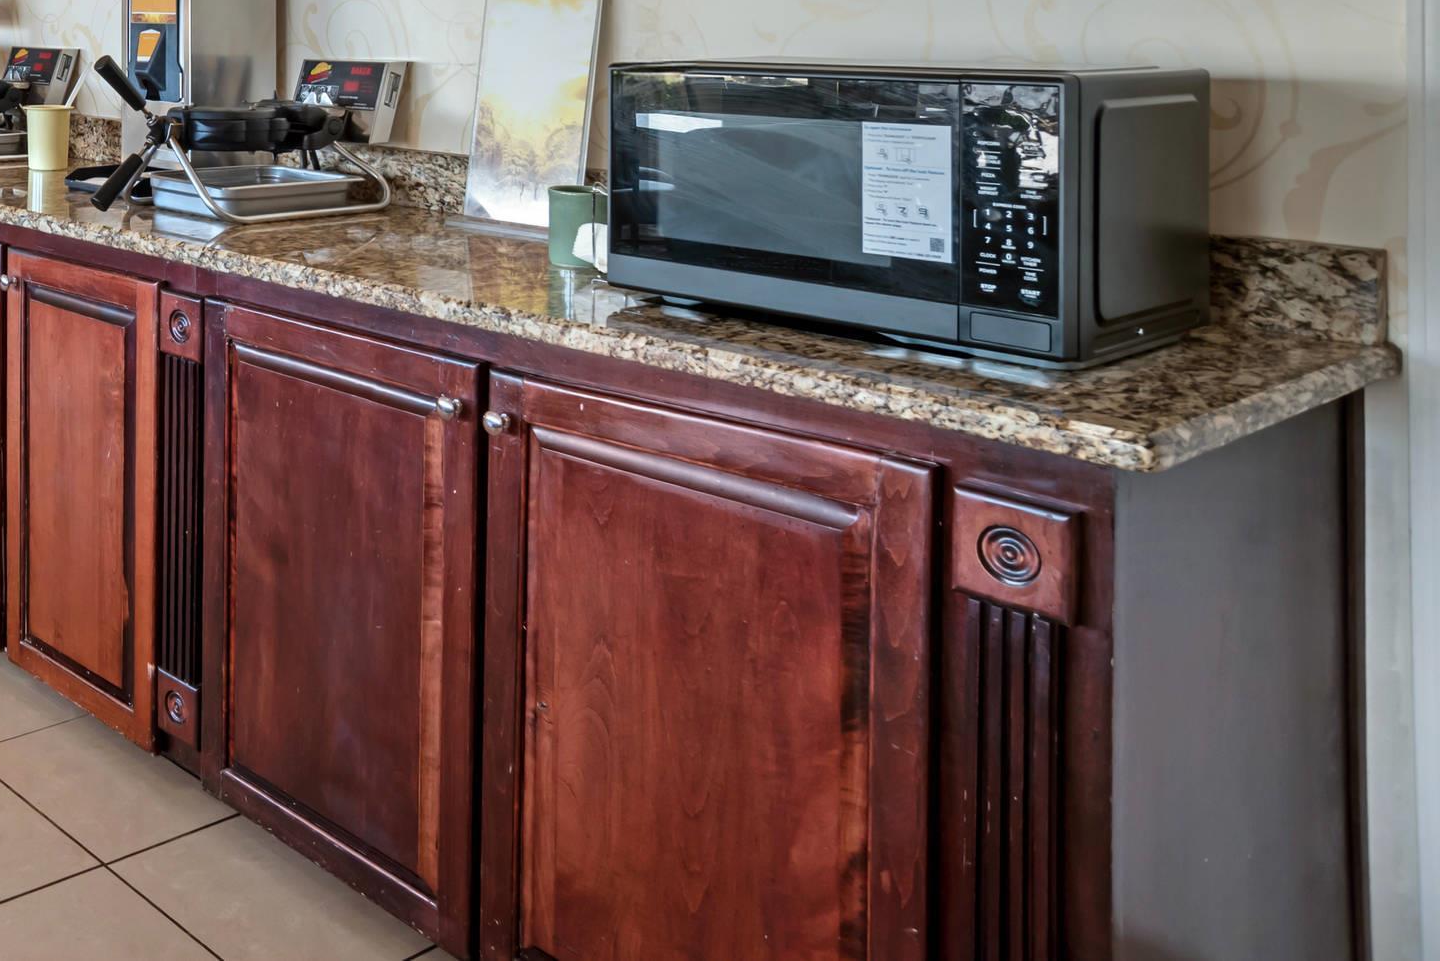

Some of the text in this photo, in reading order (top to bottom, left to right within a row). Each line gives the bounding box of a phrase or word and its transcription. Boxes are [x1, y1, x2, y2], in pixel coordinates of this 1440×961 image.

[984, 208, 990, 216] 1
[1005, 210, 1012, 218] 2
[1027, 212, 1034, 220] 3
[984, 222, 991, 230] 4
[1006, 224, 1013, 232] 5
[1027, 227, 1034, 235] 6
[984, 236, 991, 244] 7
[1027, 241, 1034, 249] 9
